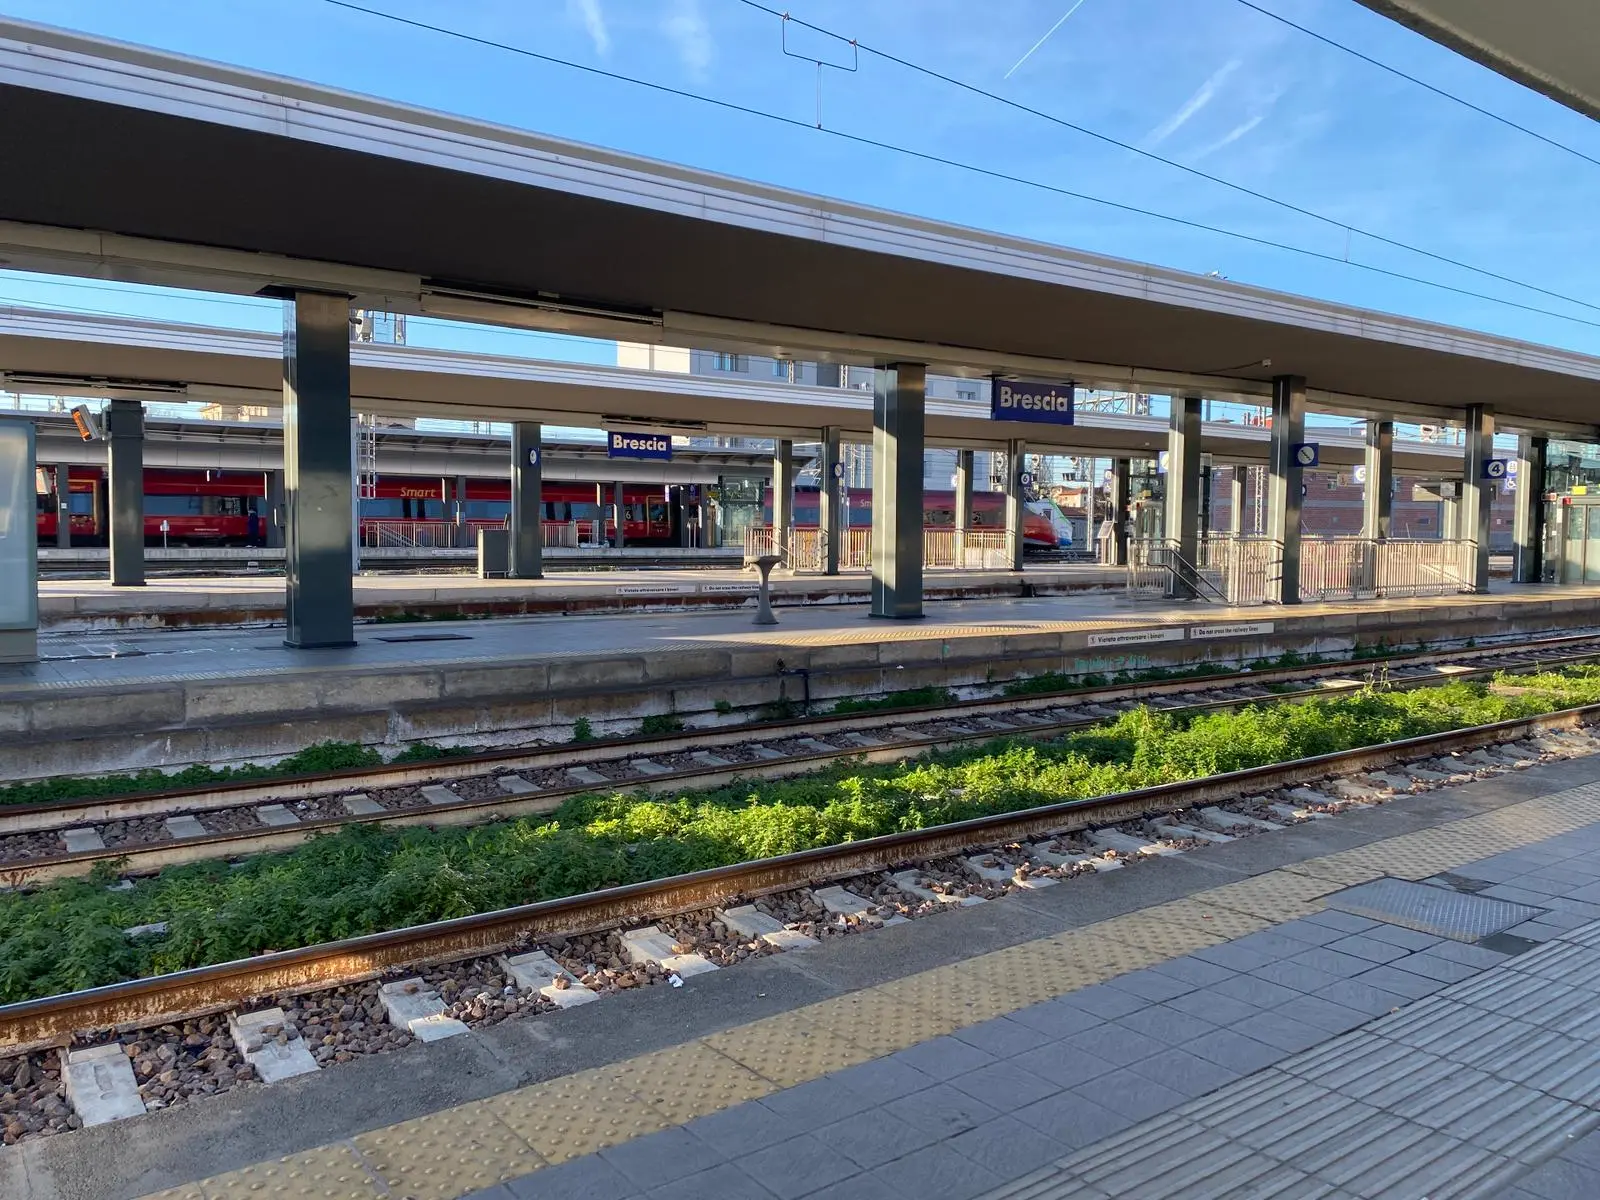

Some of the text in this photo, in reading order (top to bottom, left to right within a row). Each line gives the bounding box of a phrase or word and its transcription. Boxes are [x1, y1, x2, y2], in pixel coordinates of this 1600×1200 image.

[1000, 386, 1068, 412] Brescia
[613, 434, 667, 451] Brescia
[400, 487, 436, 498] Smart
